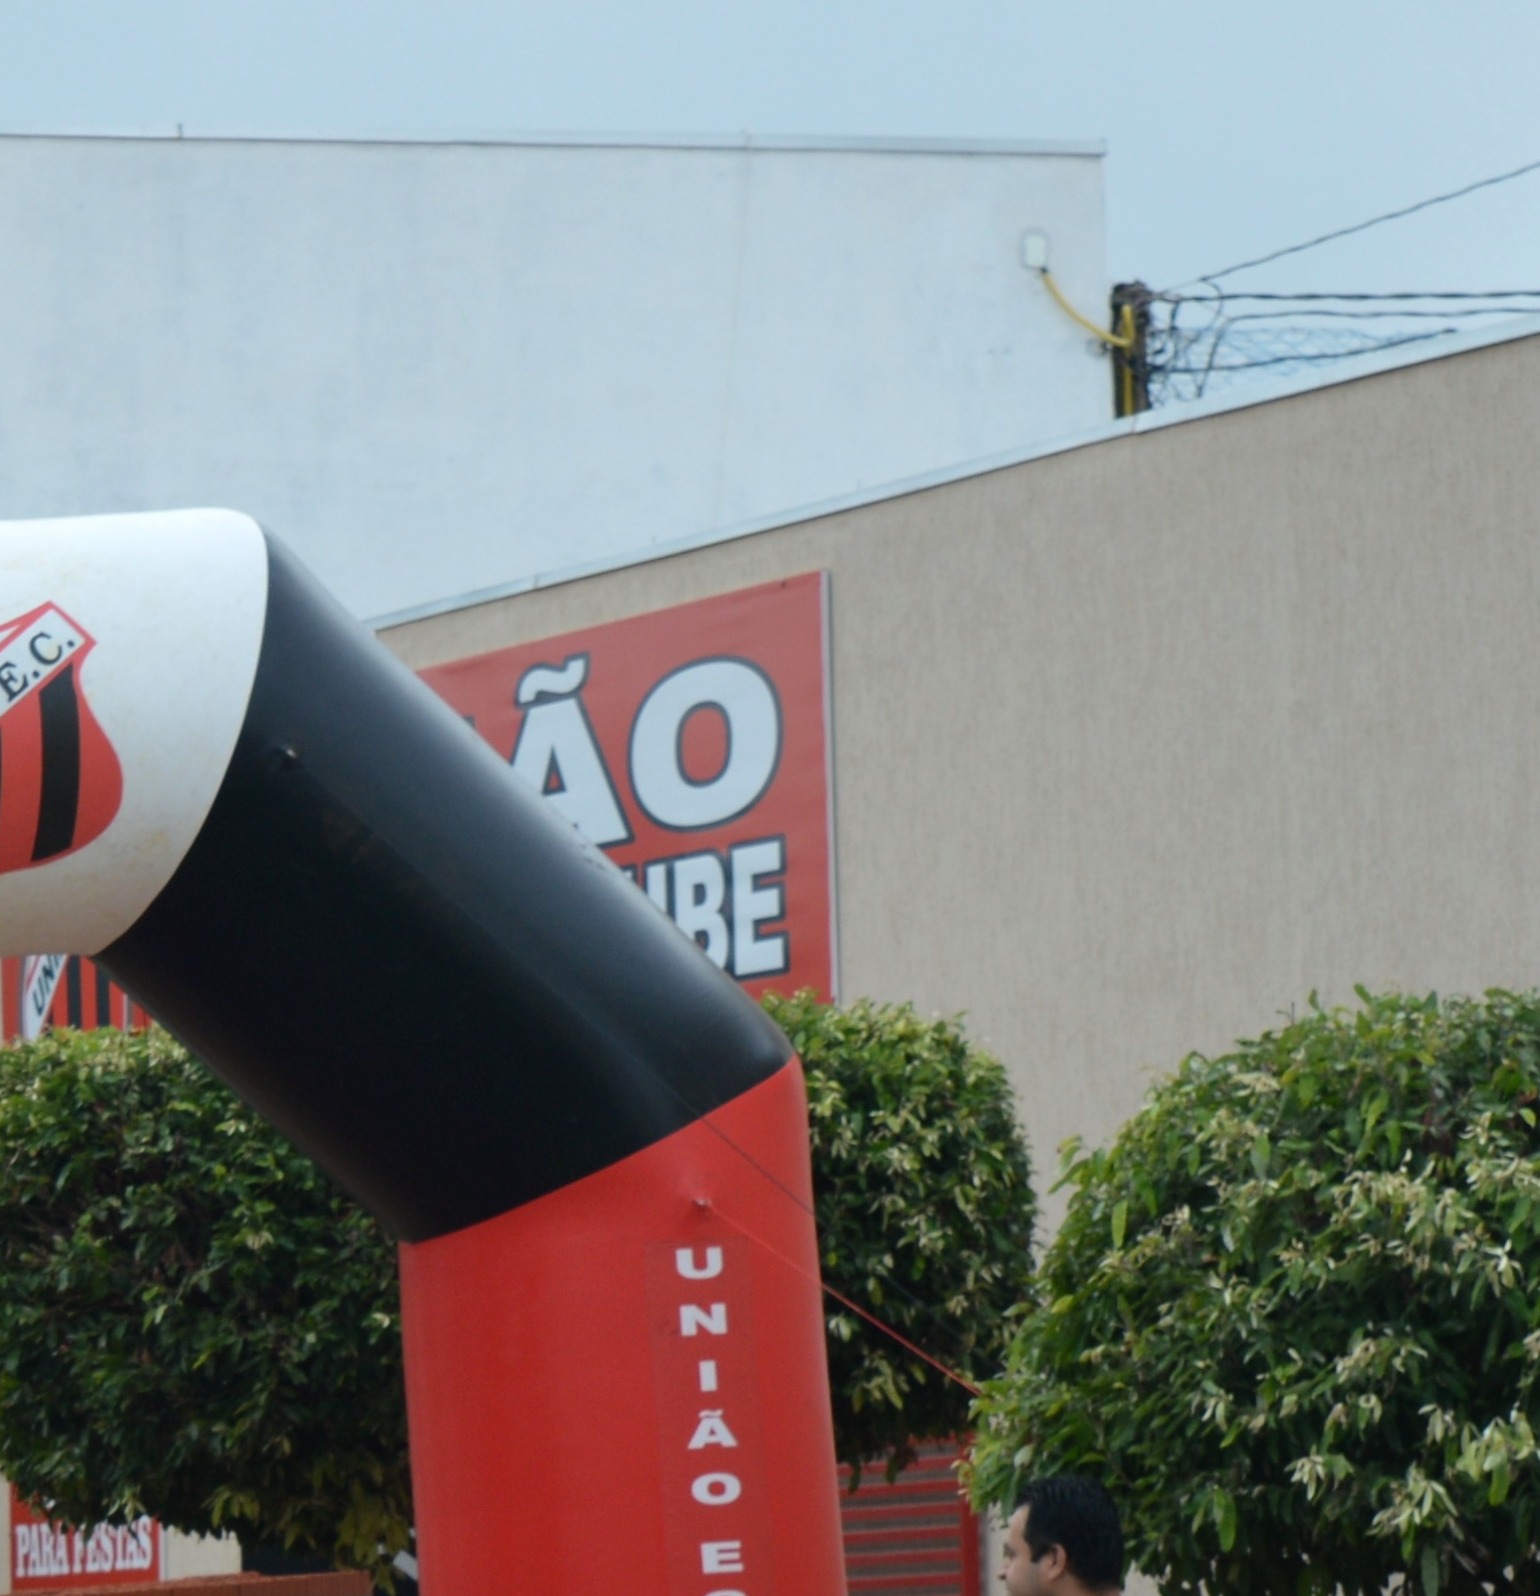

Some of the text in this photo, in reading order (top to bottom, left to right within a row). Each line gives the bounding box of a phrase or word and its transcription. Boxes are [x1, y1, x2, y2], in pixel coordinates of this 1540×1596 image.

[5, 630, 78, 707] E.C.
[675, 1246, 742, 1506] UNIÃO
[16, 1520, 70, 1578] PARA
